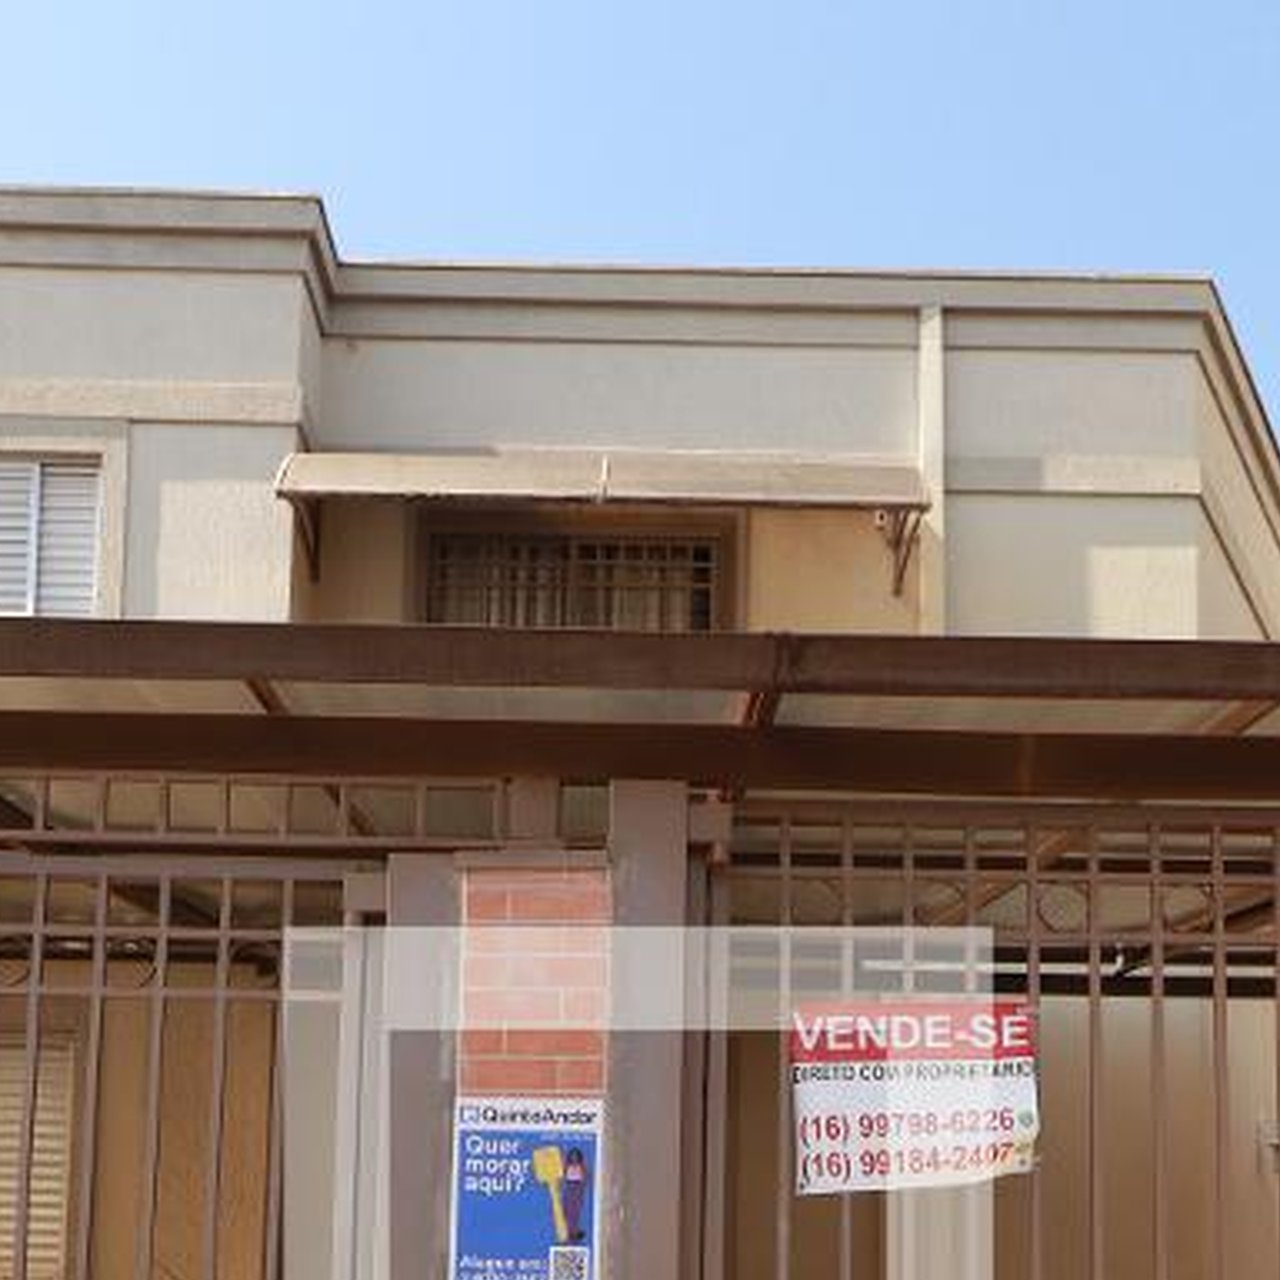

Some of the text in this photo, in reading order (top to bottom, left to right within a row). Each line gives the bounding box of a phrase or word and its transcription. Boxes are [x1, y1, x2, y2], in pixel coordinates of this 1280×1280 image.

[793, 1012, 1029, 1051] VENDE-SE
[800, 1107, 1015, 1147] (16) 99798-6226
[466, 1135, 519, 1154] Quer
[466, 1158, 531, 1173] morar
[801, 1151, 851, 1183] (16)
[465, 1174, 525, 1196] aqui?
